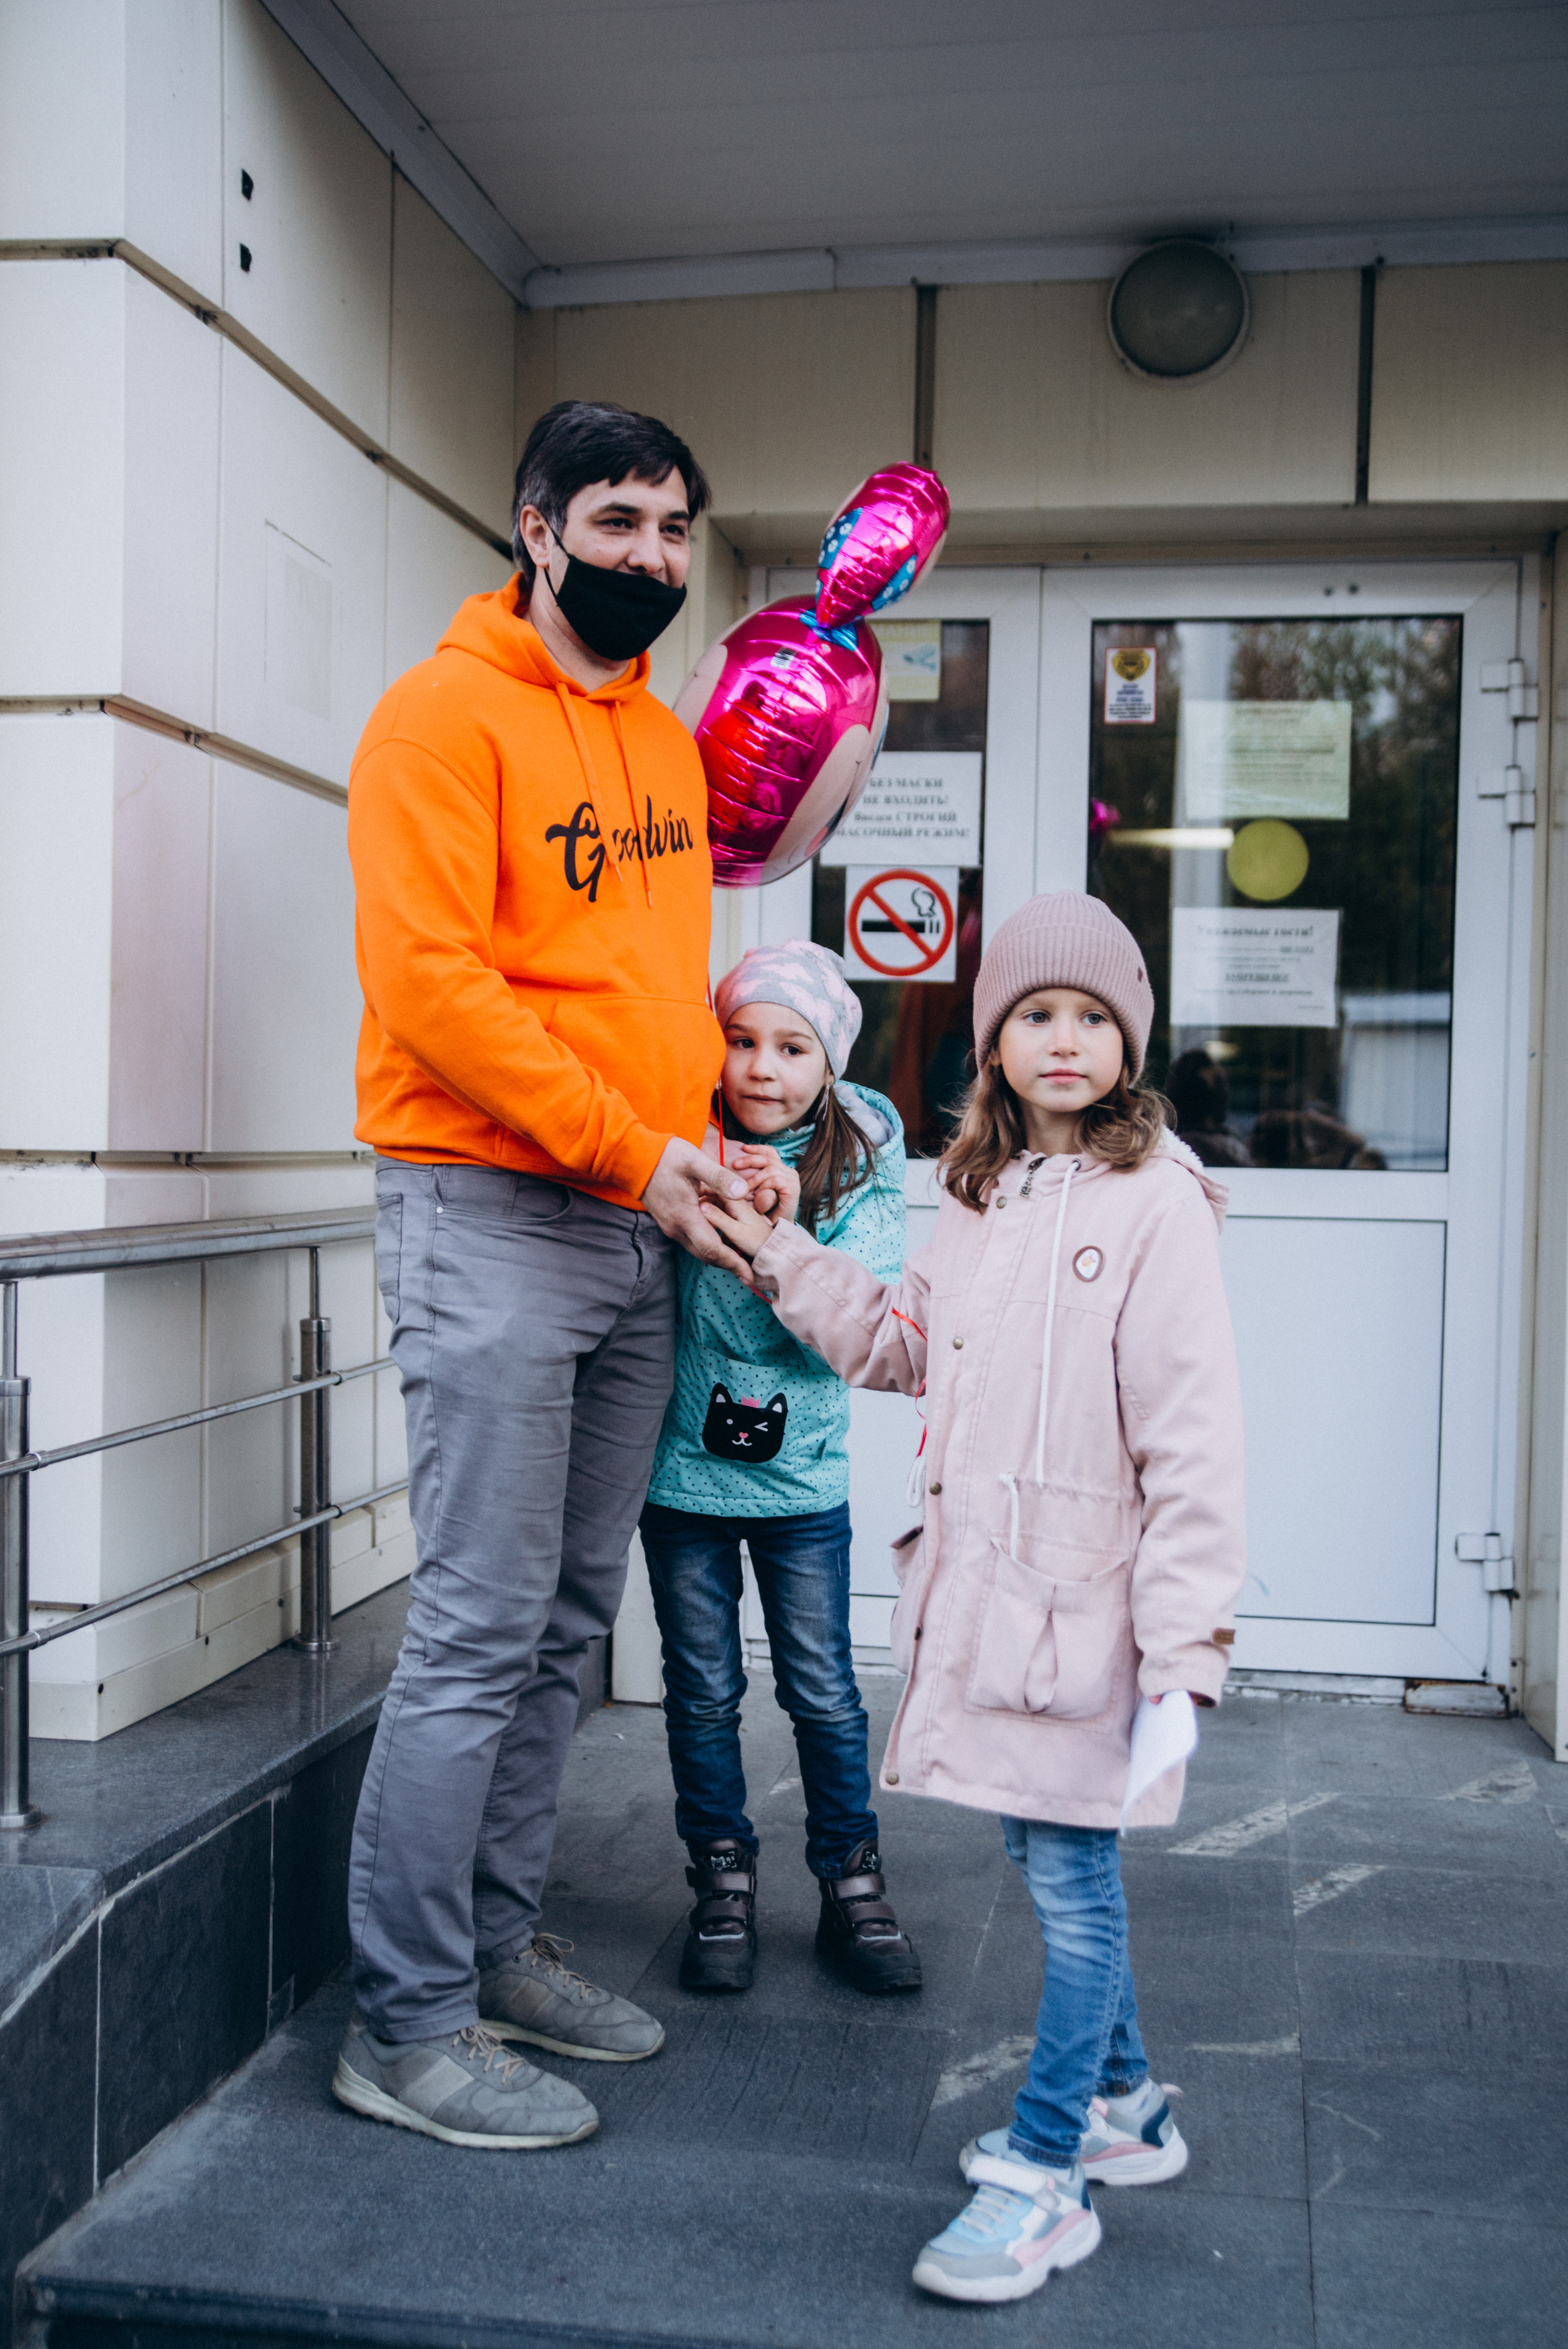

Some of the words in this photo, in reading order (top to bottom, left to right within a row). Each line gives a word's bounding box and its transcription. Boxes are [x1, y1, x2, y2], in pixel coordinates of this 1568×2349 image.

[870, 777, 892, 787] БЕЗ
[896, 777, 944, 787] МАСКИ
[863, 795, 878, 804] НЕ
[884, 795, 949, 805] ВХОДИТЬ!
[895, 810, 957, 821] СТРОГИЙ
[916, 828, 970, 838] РЕЖИМ!
[545, 794, 693, 902] Goodwin
